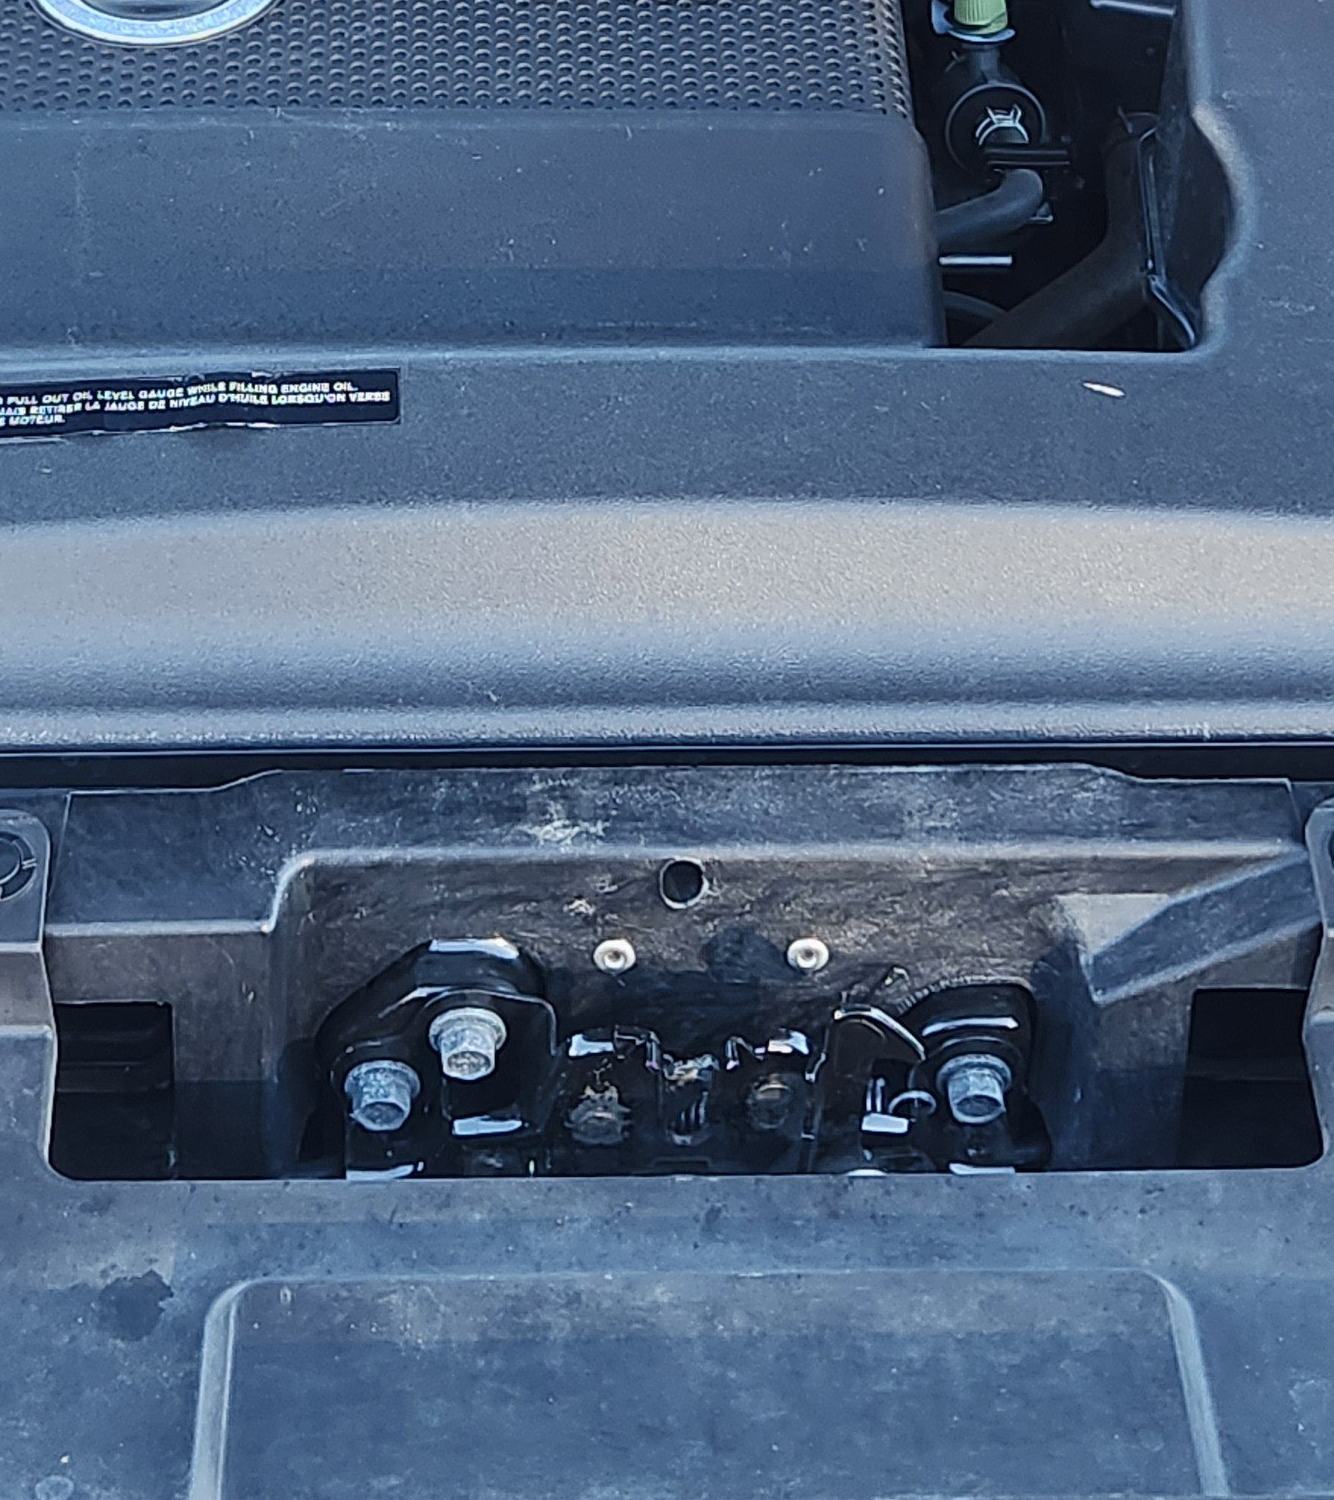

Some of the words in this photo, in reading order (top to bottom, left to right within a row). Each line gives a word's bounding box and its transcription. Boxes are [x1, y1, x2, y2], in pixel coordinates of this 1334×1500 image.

[7, 395, 38, 406] PULL
[42, 393, 69, 404] OUT
[72, 392, 93, 403] OIL
[97, 390, 135, 401] LEVEL
[139, 388, 184, 399] GAUGE
[187, 381, 227, 395] WHILE
[229, 381, 277, 394] FILLING
[281, 382, 330, 393] ENGINE
[29, 403, 83, 415] RETIRER
[85, 401, 101, 411] LA
[104, 400, 145, 412] JAUGE
[149, 399, 166, 410] DE
[170, 394, 215, 408] NIVEAU
[349, 391, 391, 402] VERSE
